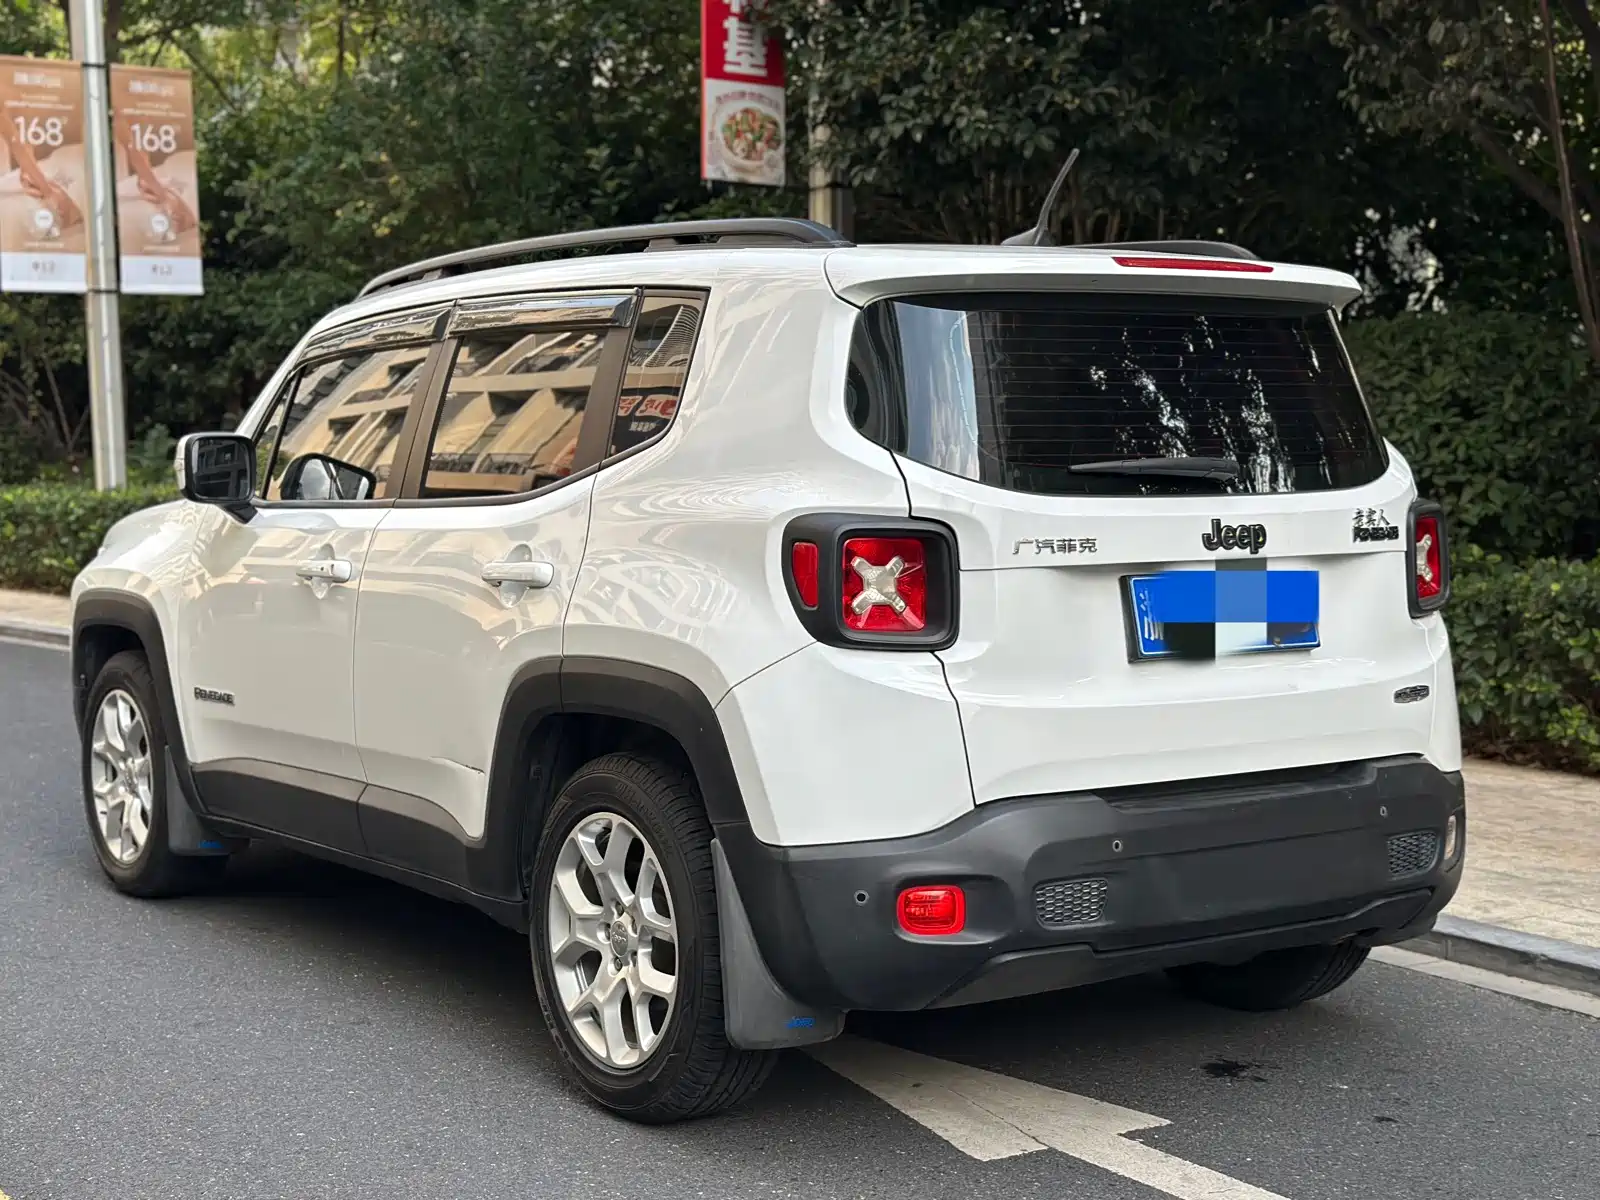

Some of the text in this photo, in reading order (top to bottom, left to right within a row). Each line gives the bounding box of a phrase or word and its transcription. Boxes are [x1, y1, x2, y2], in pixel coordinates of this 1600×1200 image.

[14, 116, 64, 146] 168
[131, 123, 177, 153] 168
[1012, 537, 1098, 555] 广汽菲克
[1202, 519, 1267, 554] Jeep
